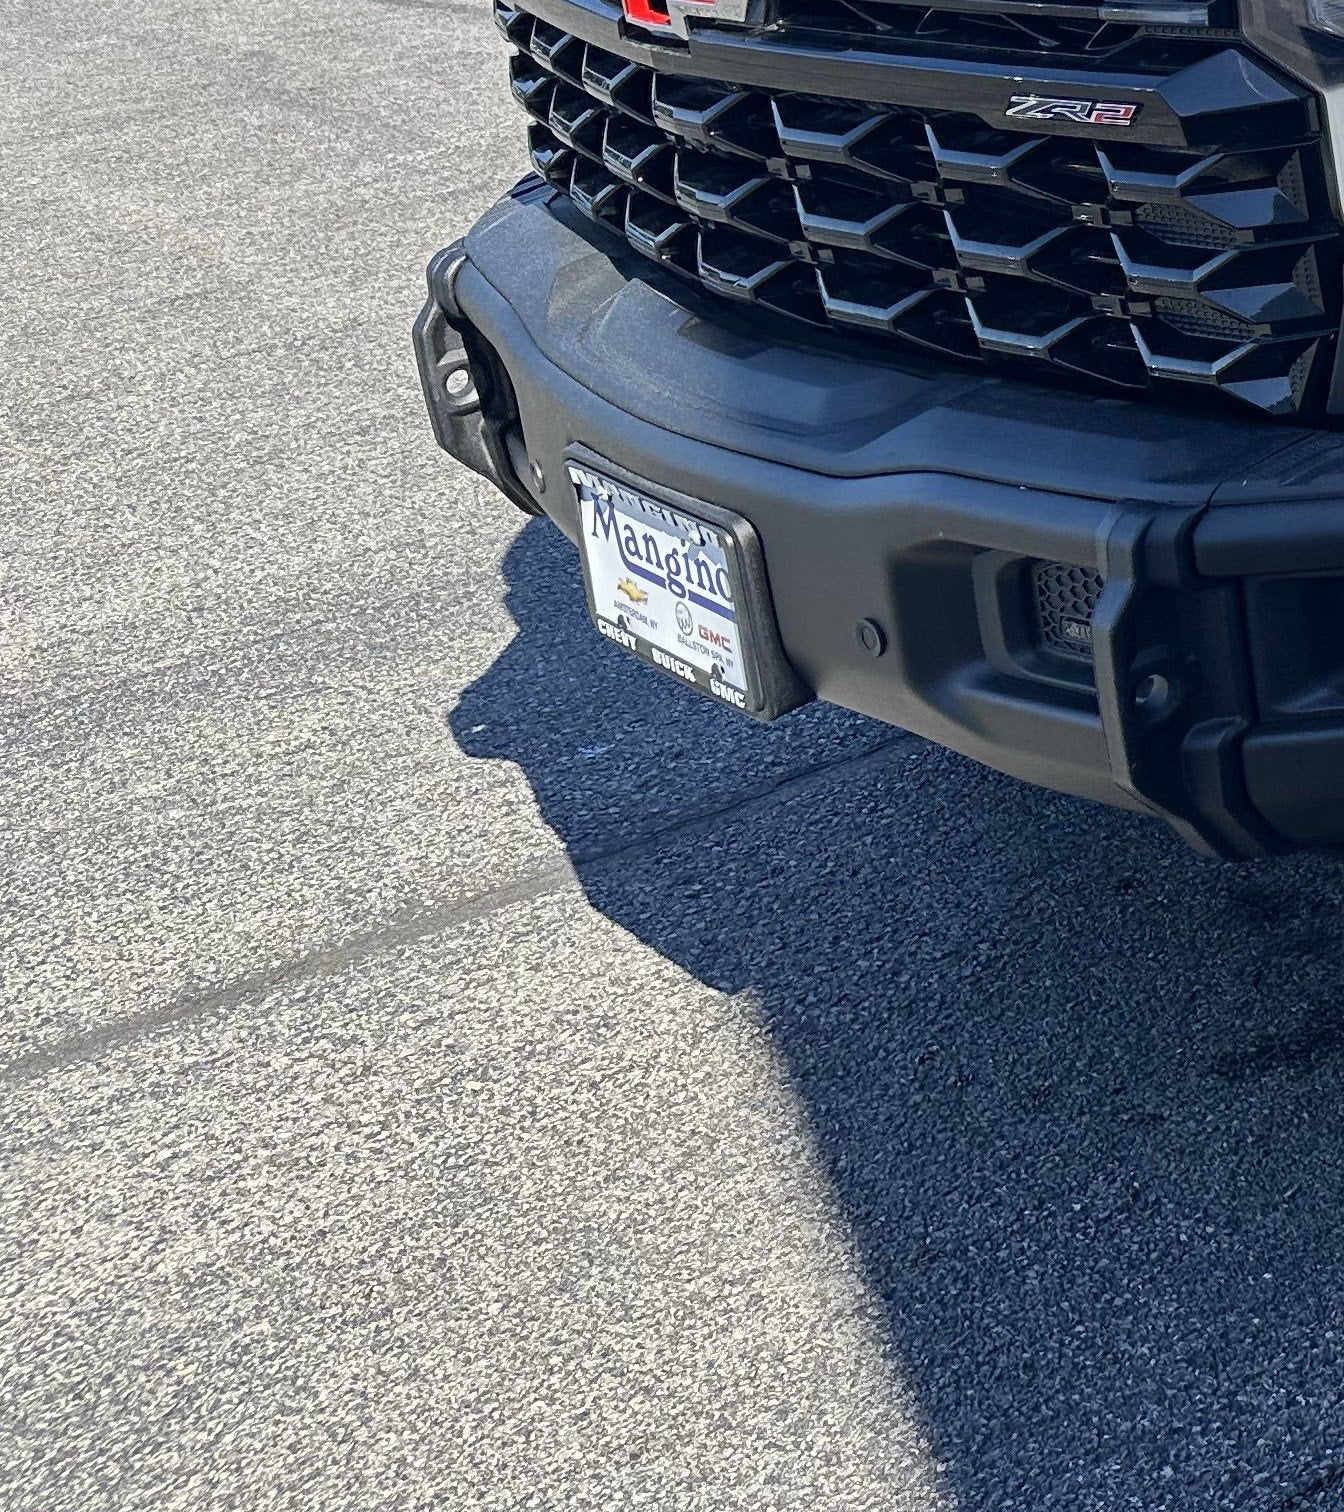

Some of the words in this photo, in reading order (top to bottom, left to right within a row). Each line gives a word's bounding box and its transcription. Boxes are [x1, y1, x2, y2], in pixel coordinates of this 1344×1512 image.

[1005, 94, 1138, 126] ZR2
[698, 624, 733, 654] GMC
[597, 618, 637, 651] CHEVY
[651, 647, 697, 683] BUICK
[709, 678, 746, 709] GMC
